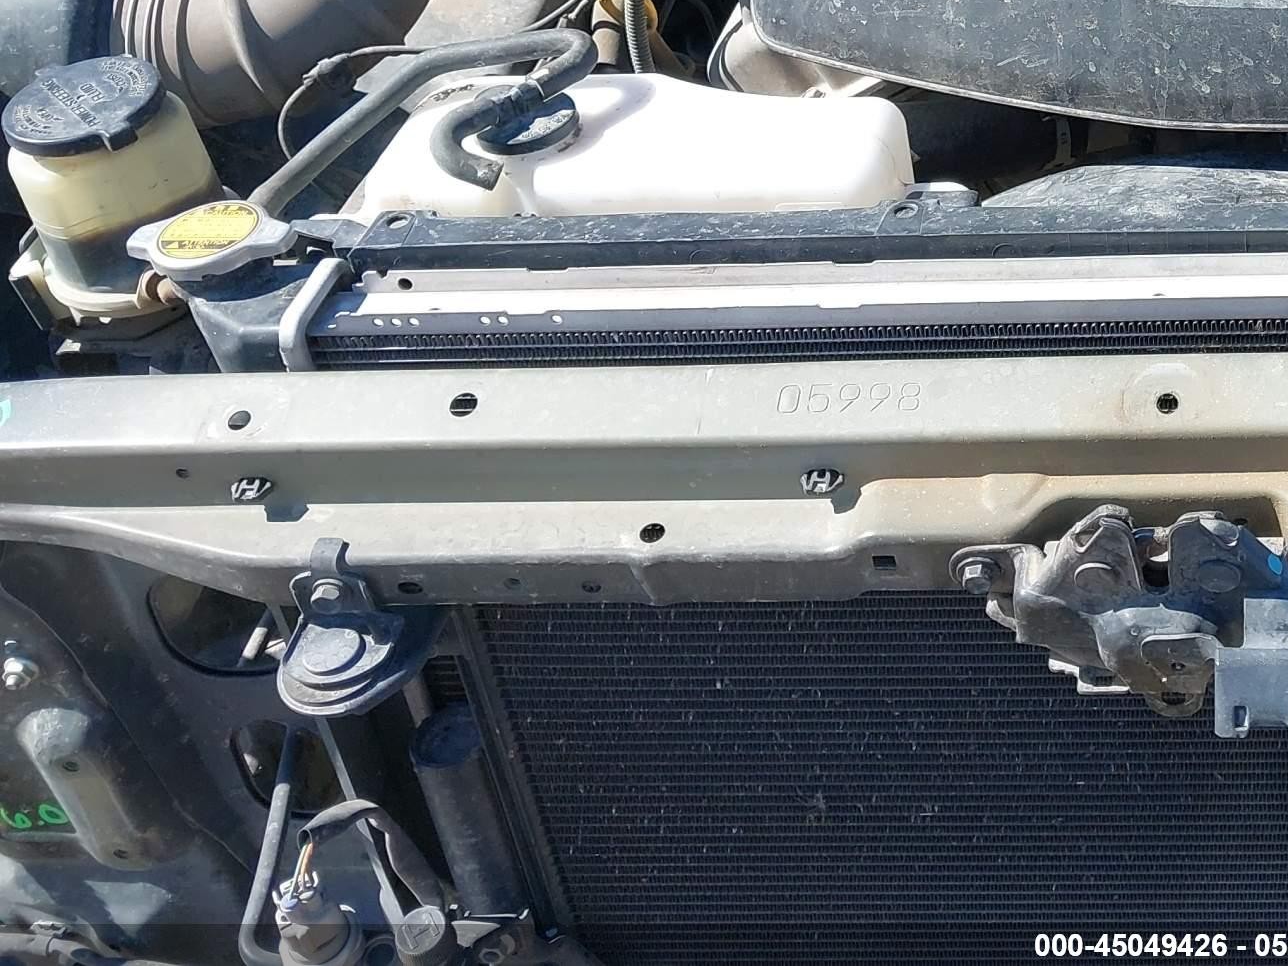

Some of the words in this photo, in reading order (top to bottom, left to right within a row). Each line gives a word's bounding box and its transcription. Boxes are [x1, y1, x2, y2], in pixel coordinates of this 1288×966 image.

[79, 82, 105, 102] FLUID
[72, 100, 101, 127] POWER
[776, 382, 922, 414] 05998
